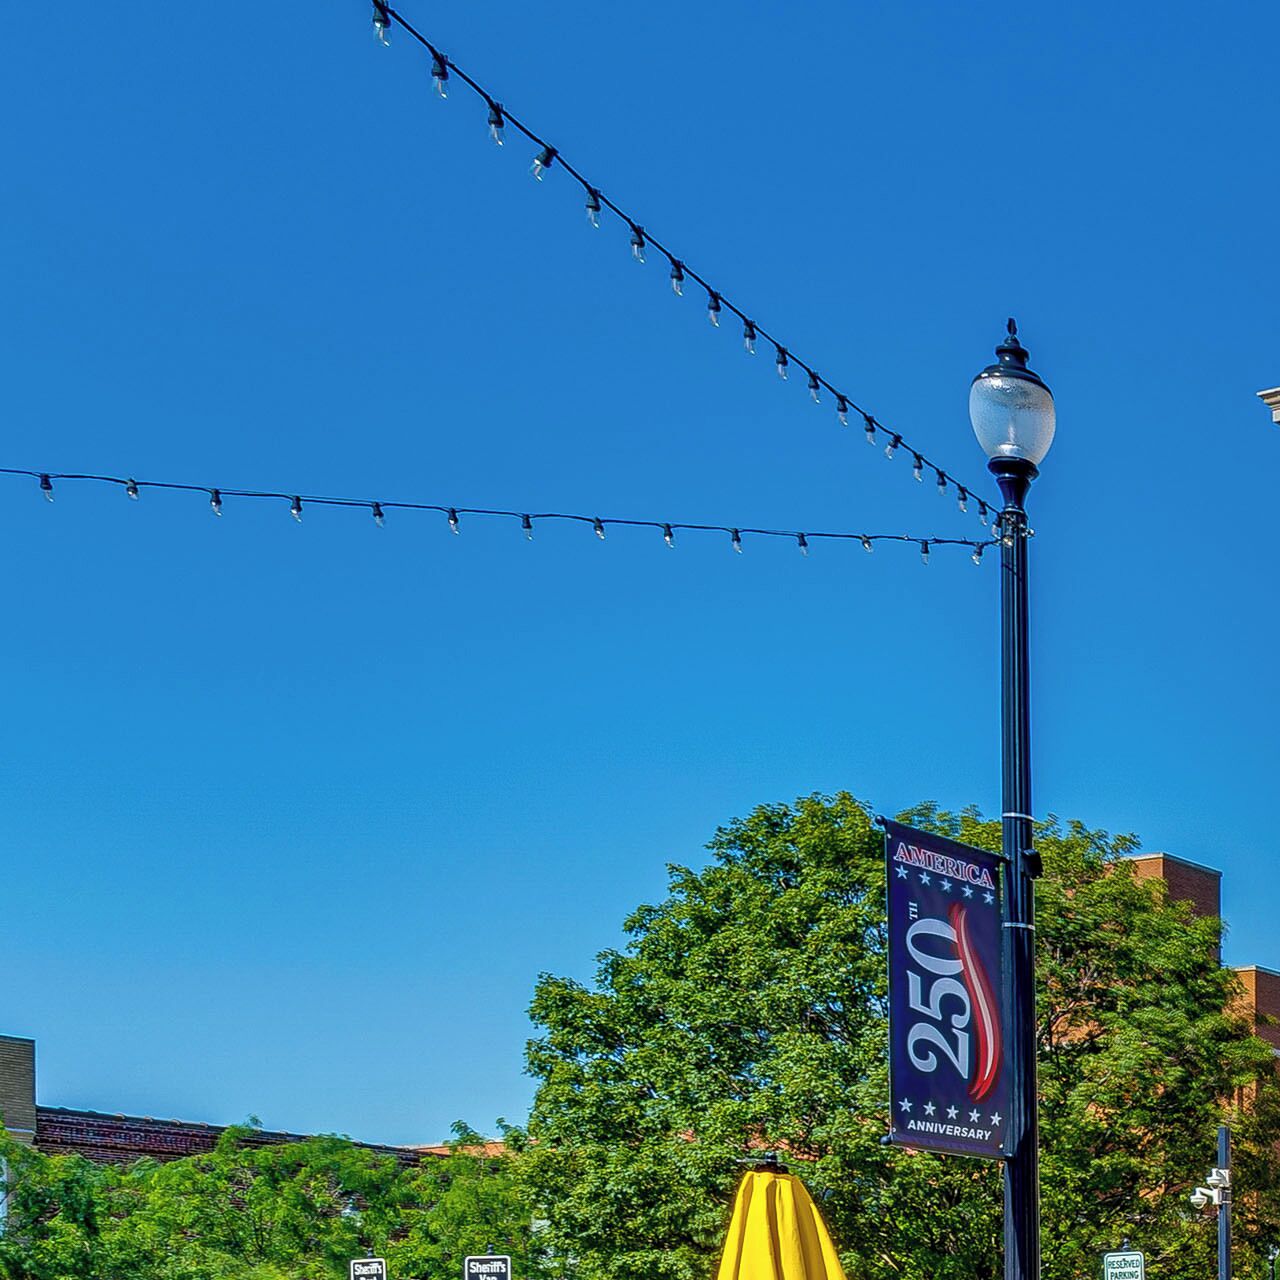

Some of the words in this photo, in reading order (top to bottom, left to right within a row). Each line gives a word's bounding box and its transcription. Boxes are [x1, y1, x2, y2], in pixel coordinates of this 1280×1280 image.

[893, 841, 995, 890] AMERICA
[907, 1119, 992, 1141] ANNIVERSARY
[354, 1263, 382, 1275] Sheriff's
[469, 1261, 506, 1273] Sheriff's
[1108, 1259, 1140, 1269] RESERVED
[1110, 1270, 1139, 1280] PARKING
